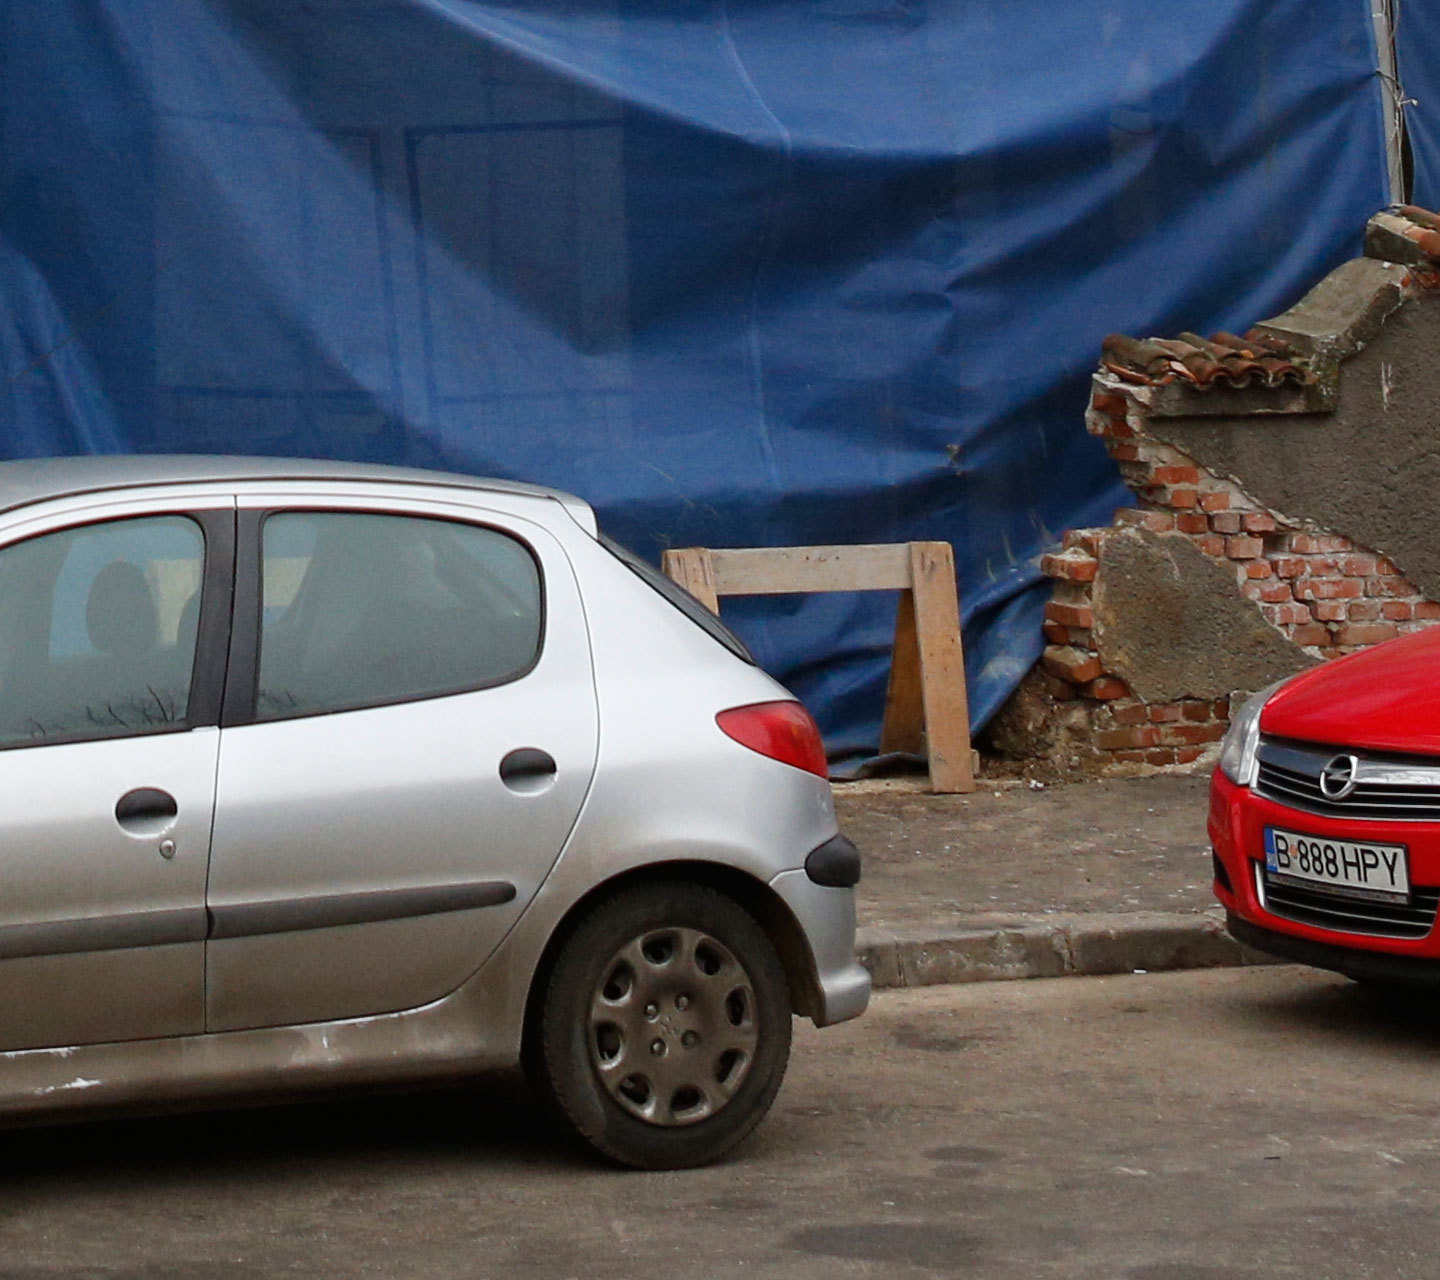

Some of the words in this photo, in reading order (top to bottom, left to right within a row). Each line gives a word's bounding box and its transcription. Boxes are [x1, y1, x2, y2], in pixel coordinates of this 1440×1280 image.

[1275, 834, 1291, 868] B
[1297, 839, 1339, 878] 888
[1340, 845, 1398, 886] HPY
